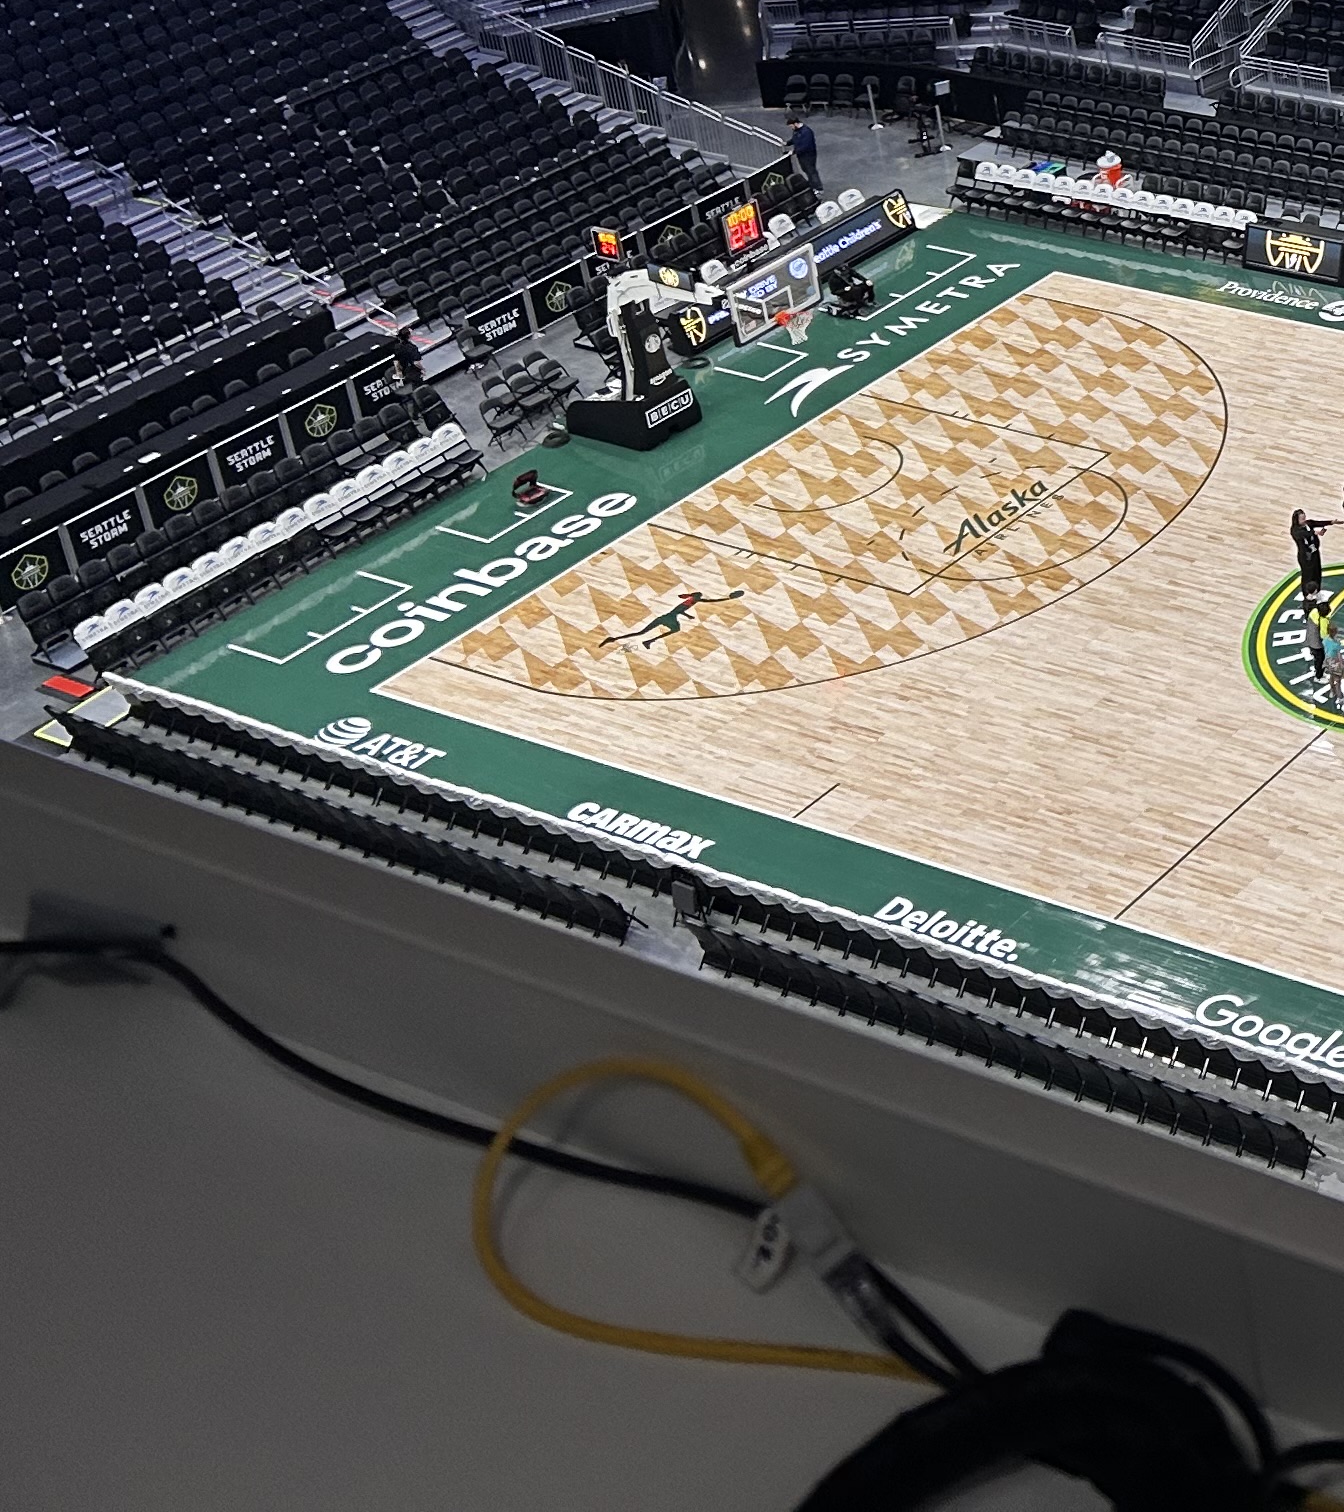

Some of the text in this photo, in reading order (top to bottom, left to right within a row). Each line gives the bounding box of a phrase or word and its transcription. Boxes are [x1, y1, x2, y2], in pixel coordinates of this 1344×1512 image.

[727, 204, 756, 227] 10:00
[729, 220, 760, 249] 24
[813, 244, 839, 264] eattle
[1216, 280, 1320, 311] Providence
[477, 308, 520, 338] SEATTLE
[836, 259, 1020, 364] SYMETRA
[486, 320, 517, 342] STORM
[648, 394, 692, 425] BECU
[226, 435, 276, 468] SEATTLE
[235, 446, 273, 474] STORM
[80, 508, 132, 543] SEATTLE
[943, 480, 1050, 557] Alaska
[89, 522, 130, 551] STORM
[326, 491, 638, 675] coinbase
[353, 733, 447, 770] AT&T
